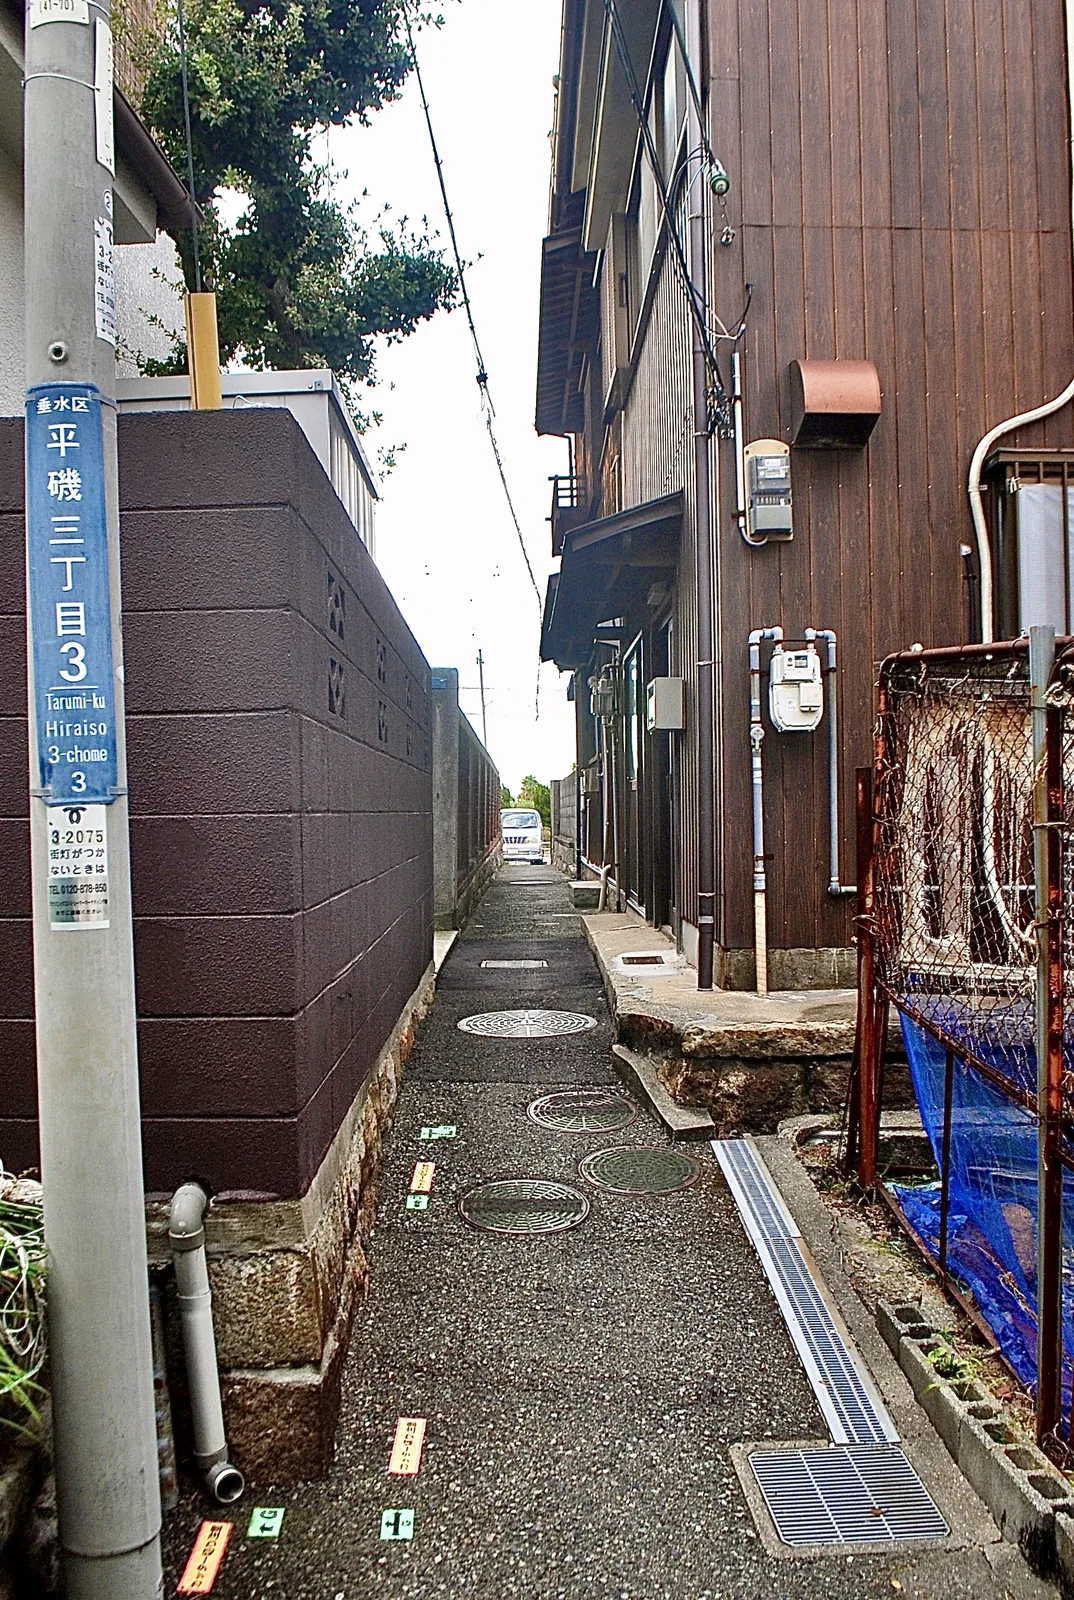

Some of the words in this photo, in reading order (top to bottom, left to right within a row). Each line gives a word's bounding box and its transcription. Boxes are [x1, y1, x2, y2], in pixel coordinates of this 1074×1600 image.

[36, 395, 90, 415] 垂水区
[44, 692, 106, 711] Tarumi-ku
[45, 720, 107, 738] Hiraiso
[48, 745, 108, 764] 3-chome
[71, 771, 87, 793] 3
[51, 829, 103, 845] 3-2075
[50, 847, 105, 860] 街灯がつか
[50, 864, 105, 875] ないときは
